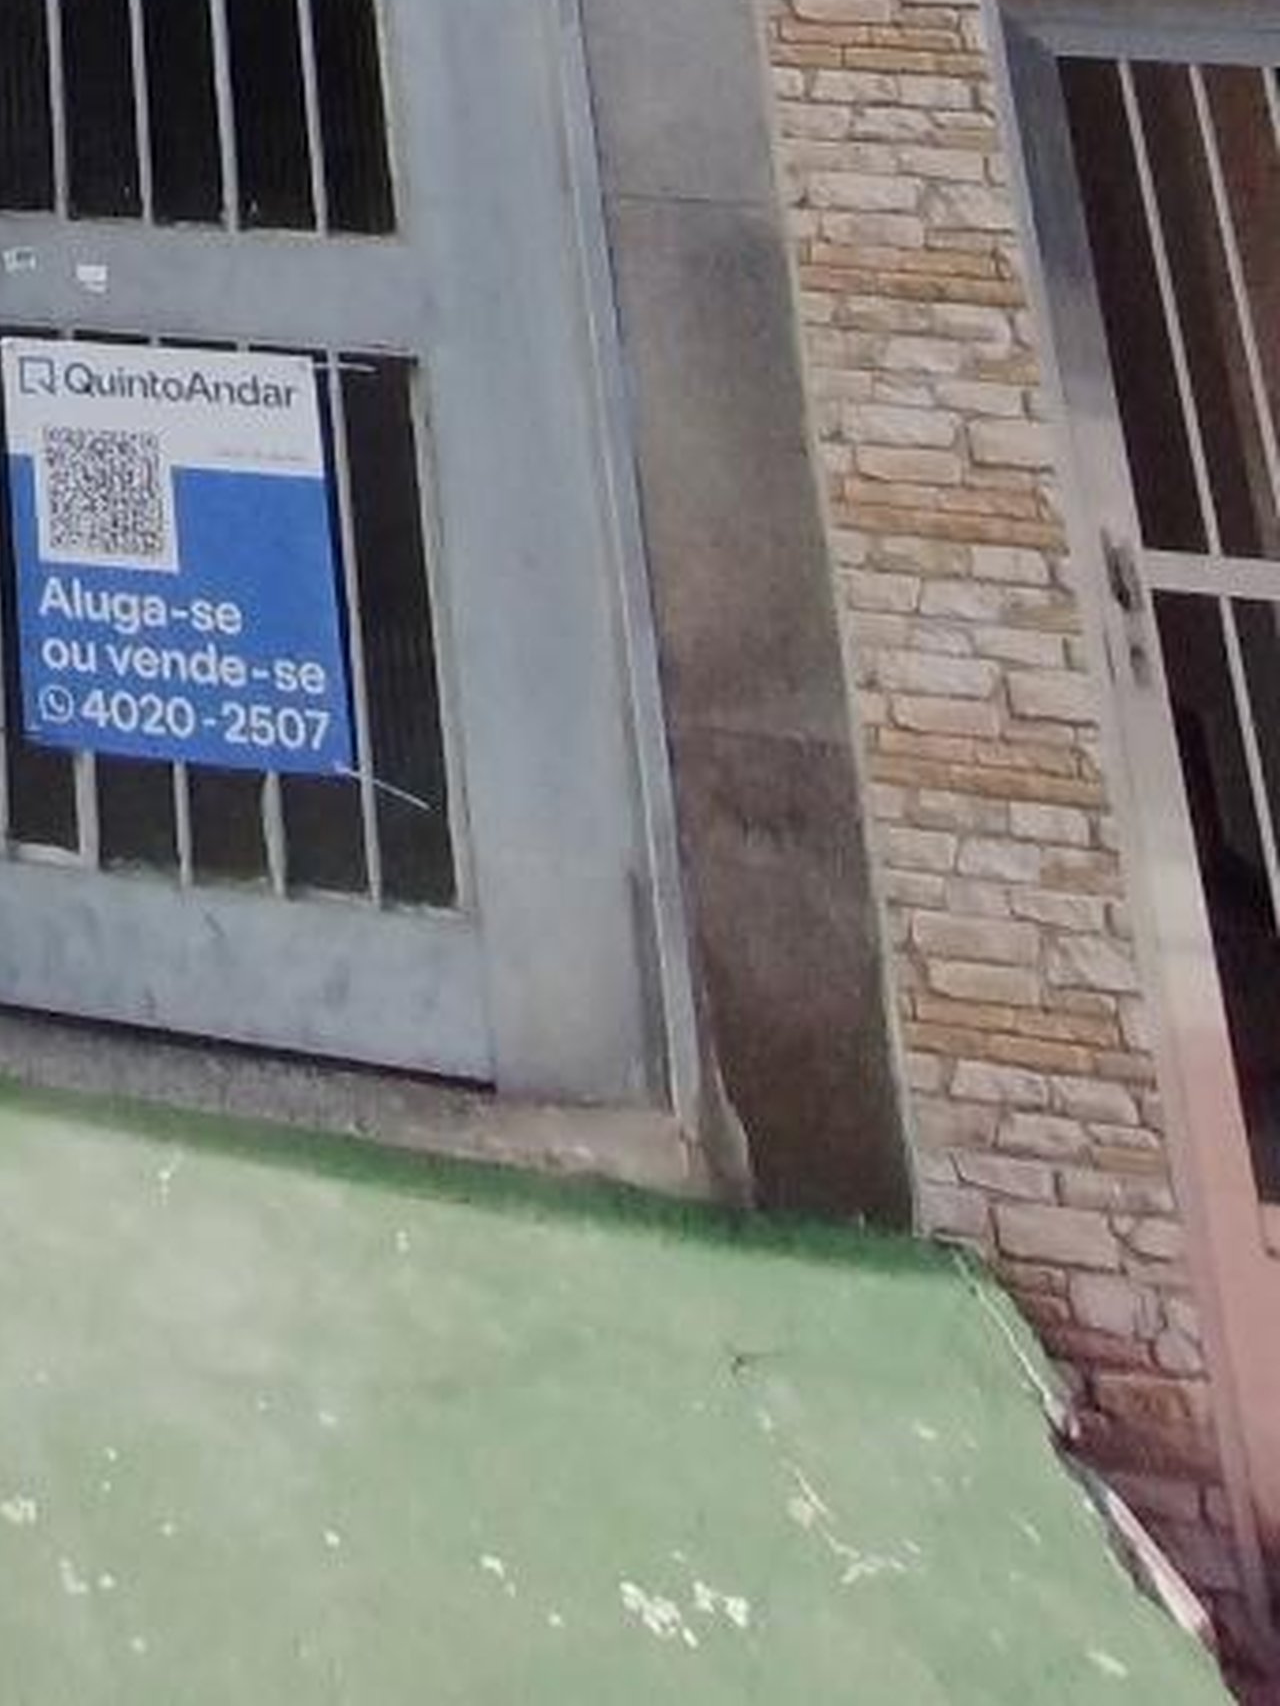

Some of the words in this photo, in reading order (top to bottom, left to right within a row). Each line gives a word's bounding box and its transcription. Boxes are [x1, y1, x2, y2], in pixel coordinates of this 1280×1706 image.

[64, 362, 297, 409] QuintoAndar
[39, 577, 243, 635] Aluga-se
[42, 638, 97, 672] ou
[107, 643, 326, 692] vende-se
[81, 689, 331, 751] 4020-2507
